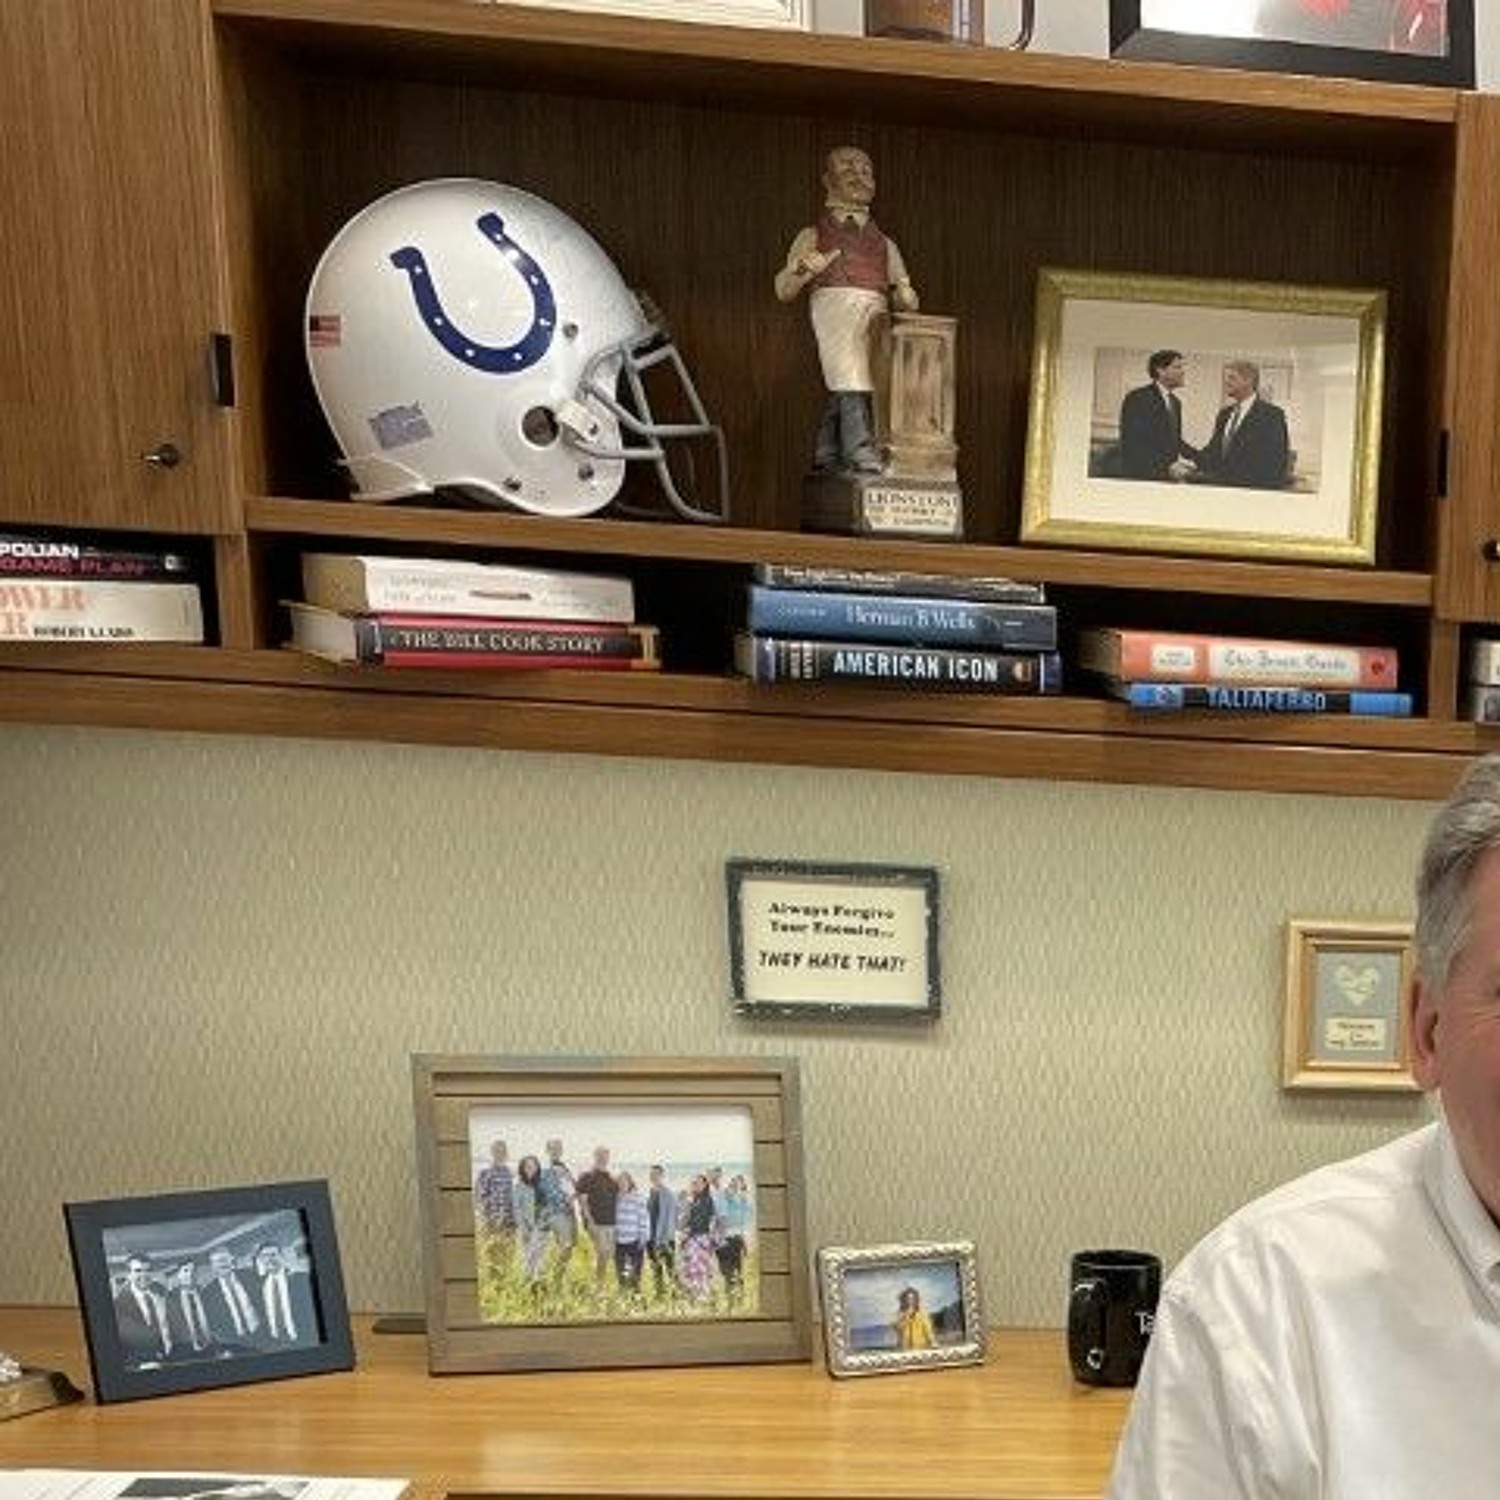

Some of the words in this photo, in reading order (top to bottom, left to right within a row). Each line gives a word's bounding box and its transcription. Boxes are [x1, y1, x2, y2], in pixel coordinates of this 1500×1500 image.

[400, 631, 438, 649] THE
[488, 632, 540, 651] COOK
[548, 633, 603, 653] STORY
[833, 651, 939, 679] AMERICAN
[948, 658, 999, 682] ICON
[768, 902, 829, 917] Always
[833, 904, 895, 920] Forgive
[769, 920, 808, 933] Your
[758, 950, 804, 968] THEY
[808, 952, 851, 970] HATE
